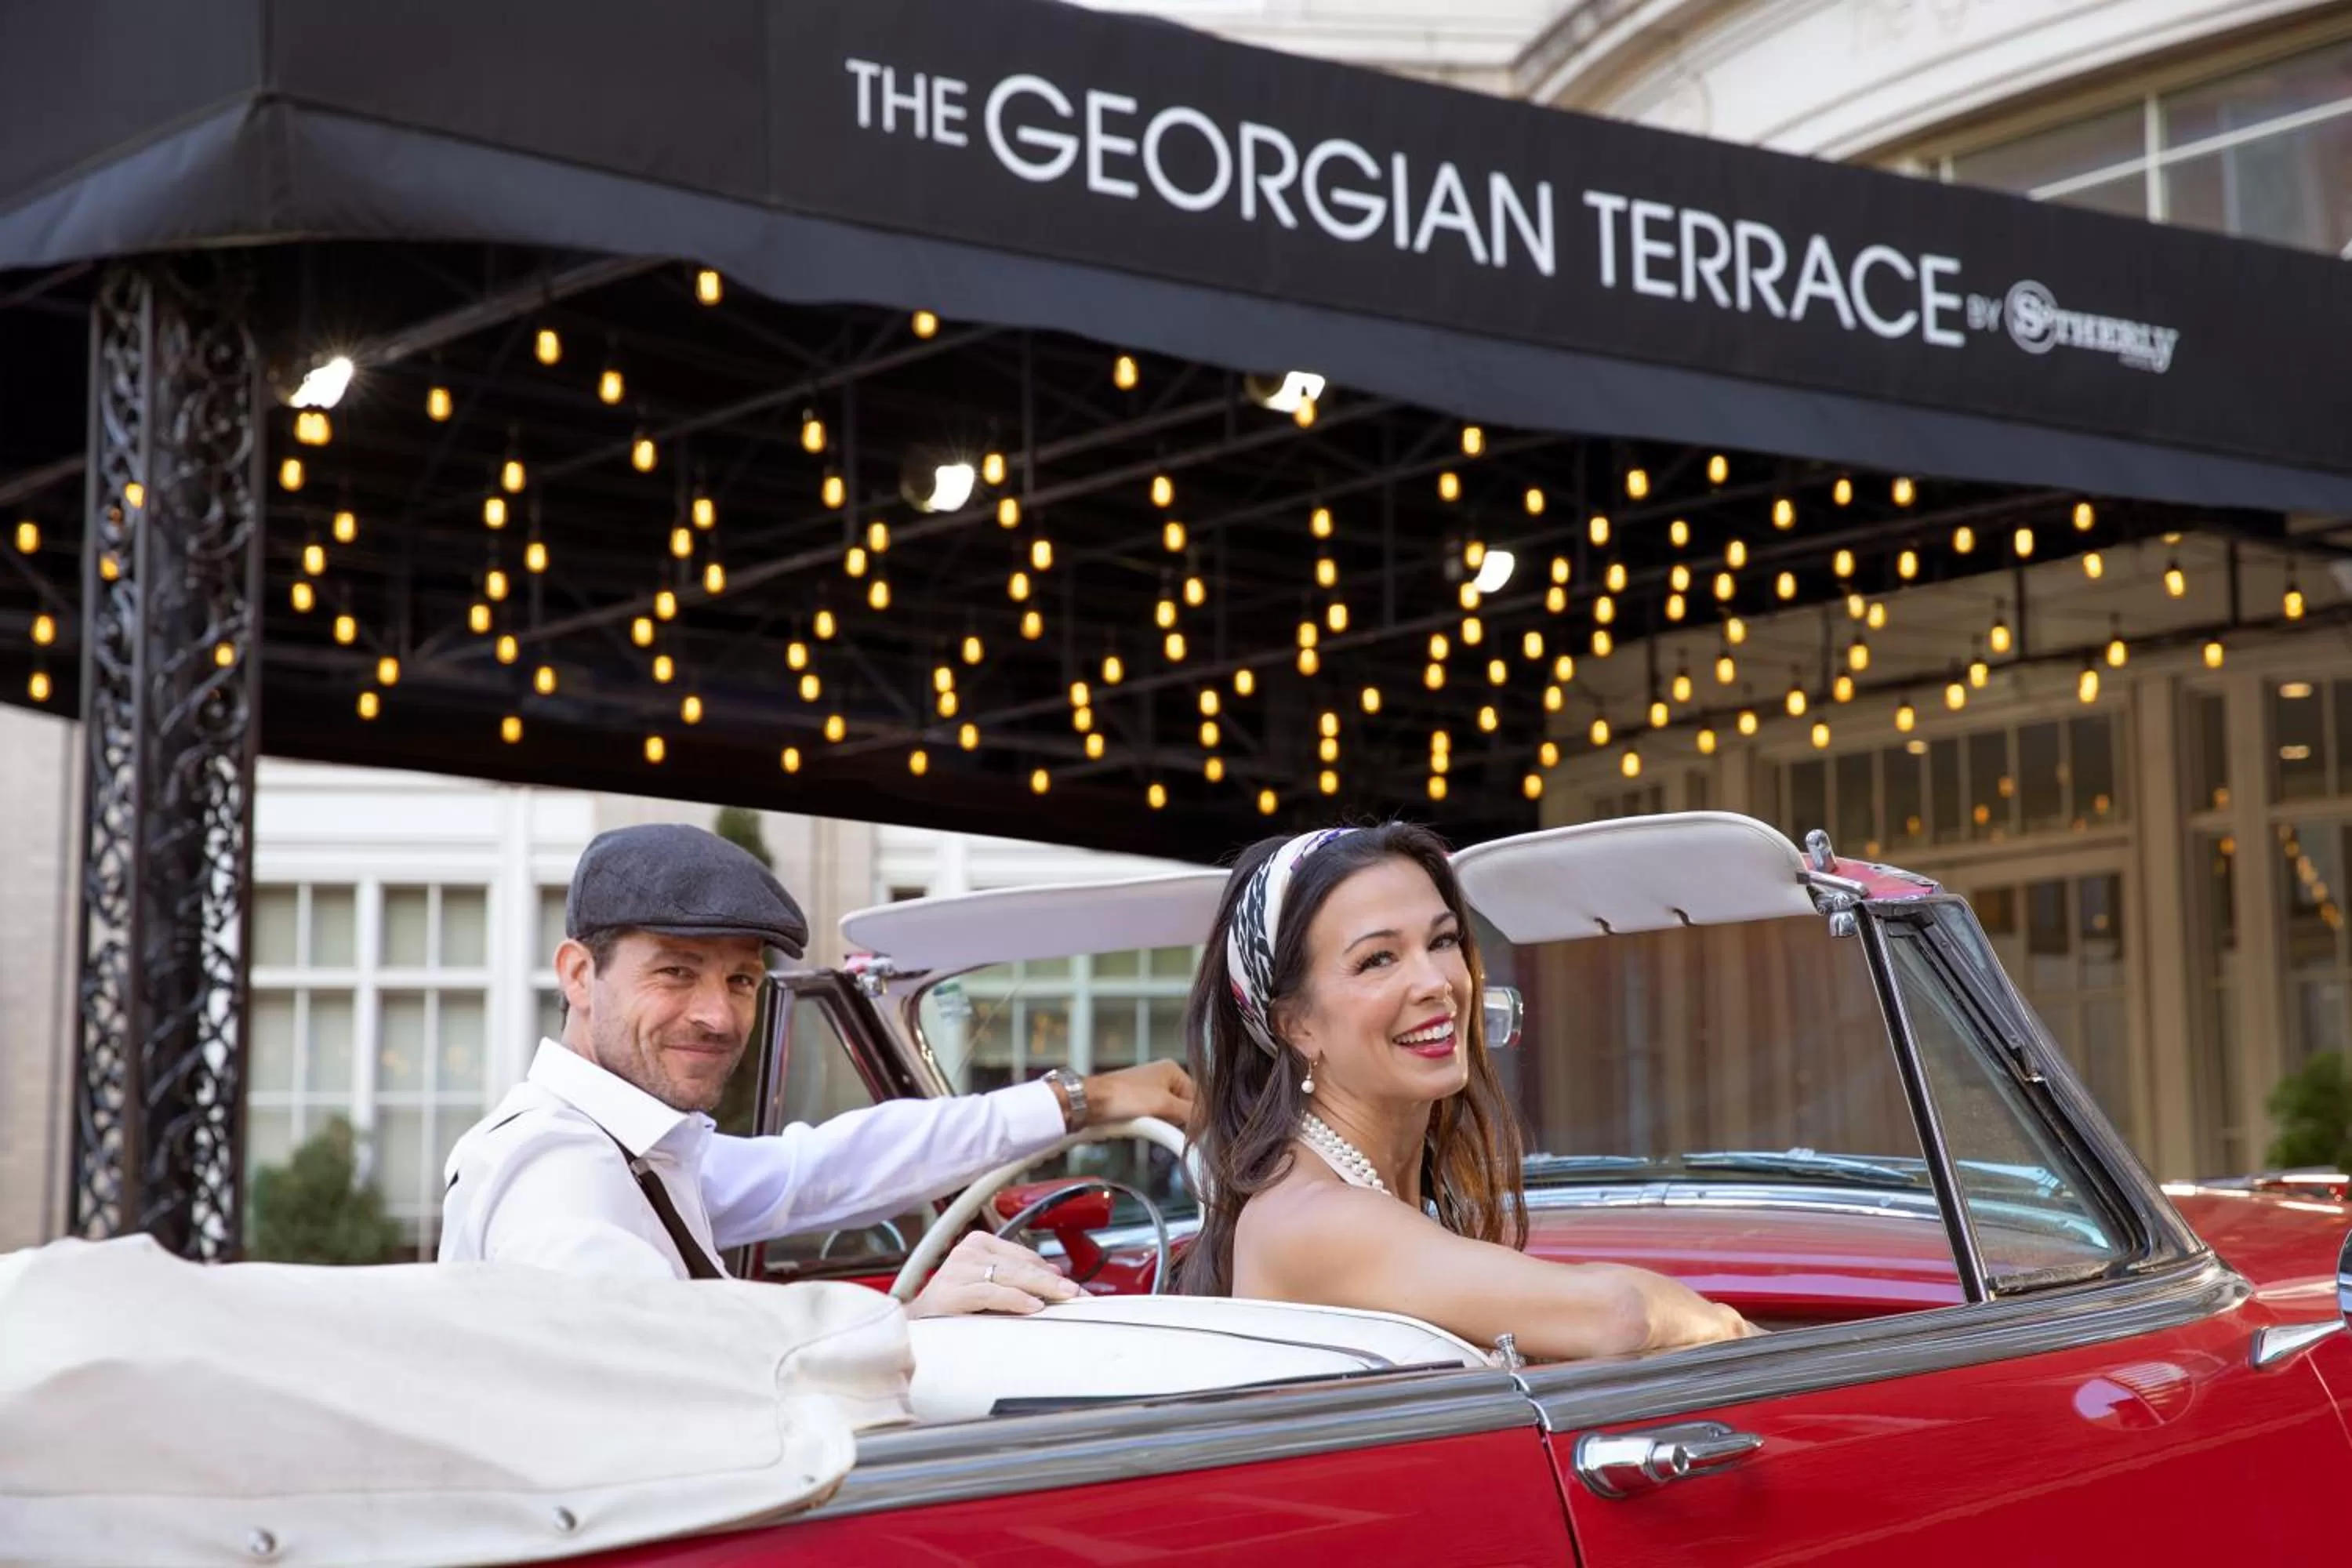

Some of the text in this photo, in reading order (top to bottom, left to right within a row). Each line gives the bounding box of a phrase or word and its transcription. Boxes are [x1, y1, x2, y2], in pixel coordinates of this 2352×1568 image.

[845, 59, 969, 147] THE
[984, 74, 1555, 276] GEORGIAN
[1584, 191, 1965, 347] TERRACE
[1966, 294, 2002, 331] BY
